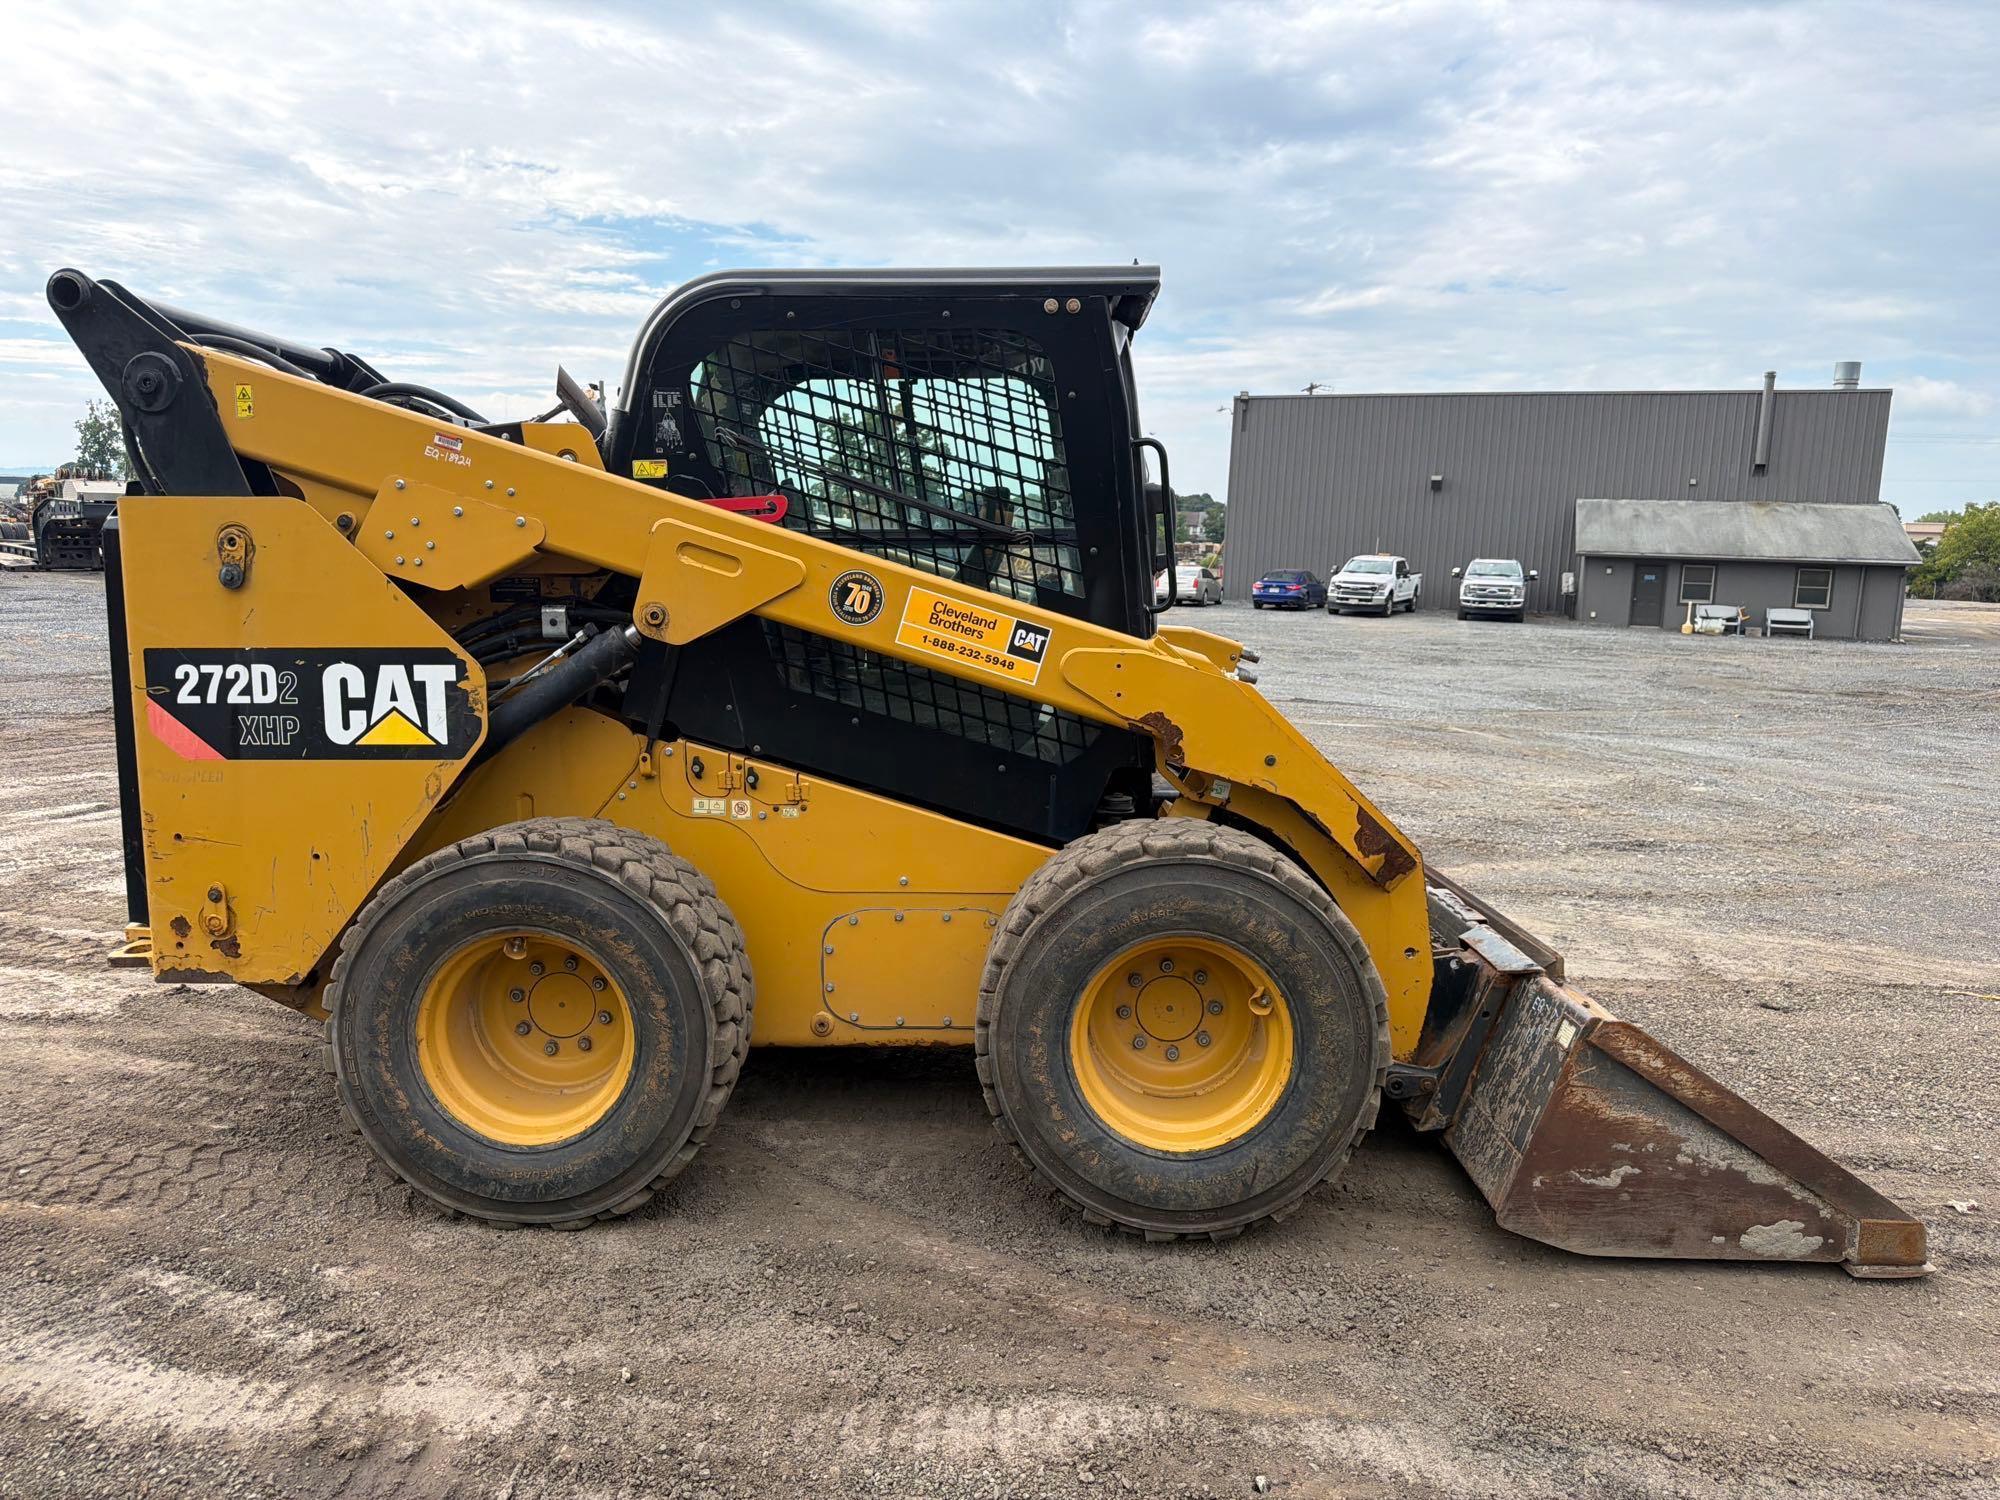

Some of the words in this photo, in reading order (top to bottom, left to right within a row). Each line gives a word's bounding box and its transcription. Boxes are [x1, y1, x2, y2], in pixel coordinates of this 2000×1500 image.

[424, 445, 472, 467] EQ-18924
[844, 582, 870, 614] 70
[928, 612, 984, 640] Brothers
[933, 601, 998, 631] Cleveland
[922, 634, 1015, 671] 1-888-232-5948
[1013, 628, 1045, 653] CAT
[322, 662, 457, 746] CAT
[238, 715, 300, 746] XHP
